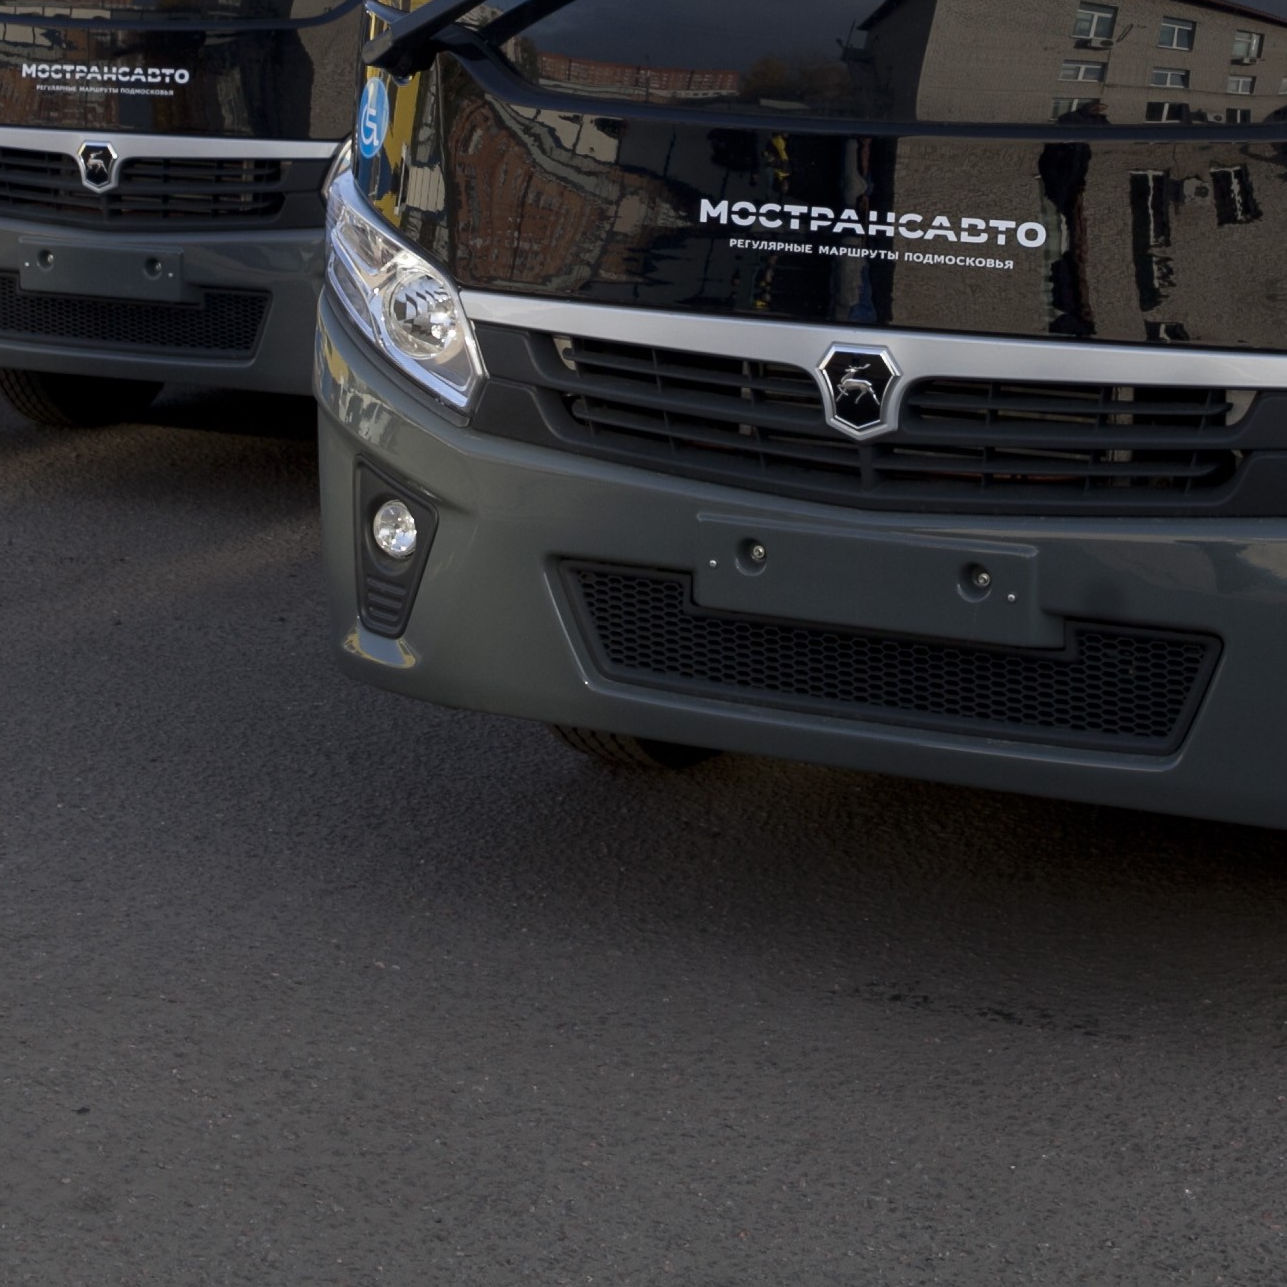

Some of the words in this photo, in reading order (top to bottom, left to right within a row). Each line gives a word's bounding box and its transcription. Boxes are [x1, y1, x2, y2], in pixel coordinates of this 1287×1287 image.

[21, 62, 190, 85] МОСТРАНСАВТО
[698, 197, 1047, 249] МОСТРАНСАВТО
[729, 238, 814, 254] РЕГУЛЯРНЫЕ
[817, 245, 900, 261] МАРШРУТЫ
[903, 252, 1015, 271] ПОДМОСКОВЬЯ
